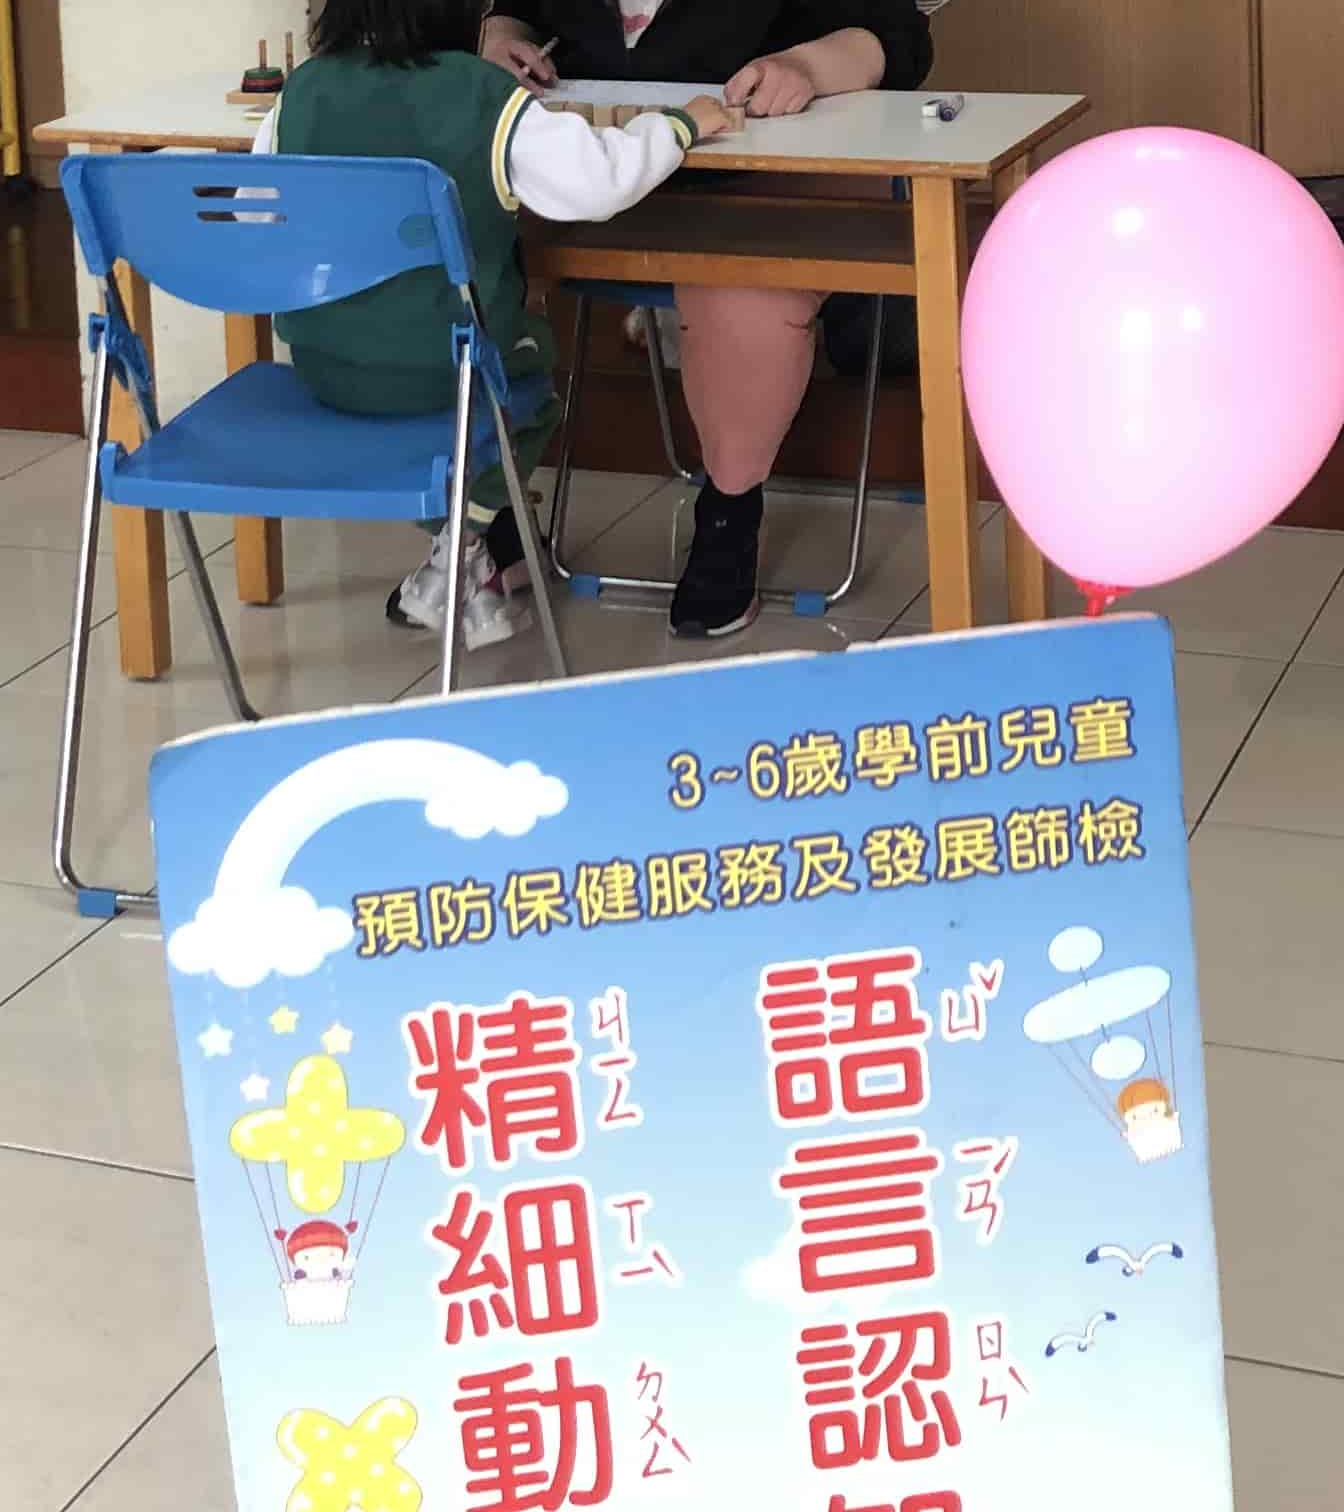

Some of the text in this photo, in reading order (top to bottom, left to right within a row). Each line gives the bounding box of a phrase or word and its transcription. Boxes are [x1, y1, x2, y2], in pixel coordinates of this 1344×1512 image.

[667, 698, 1136, 810] 3~6歲學前兒童
[353, 796, 1147, 958] 預防保健服務及發展篩檢
